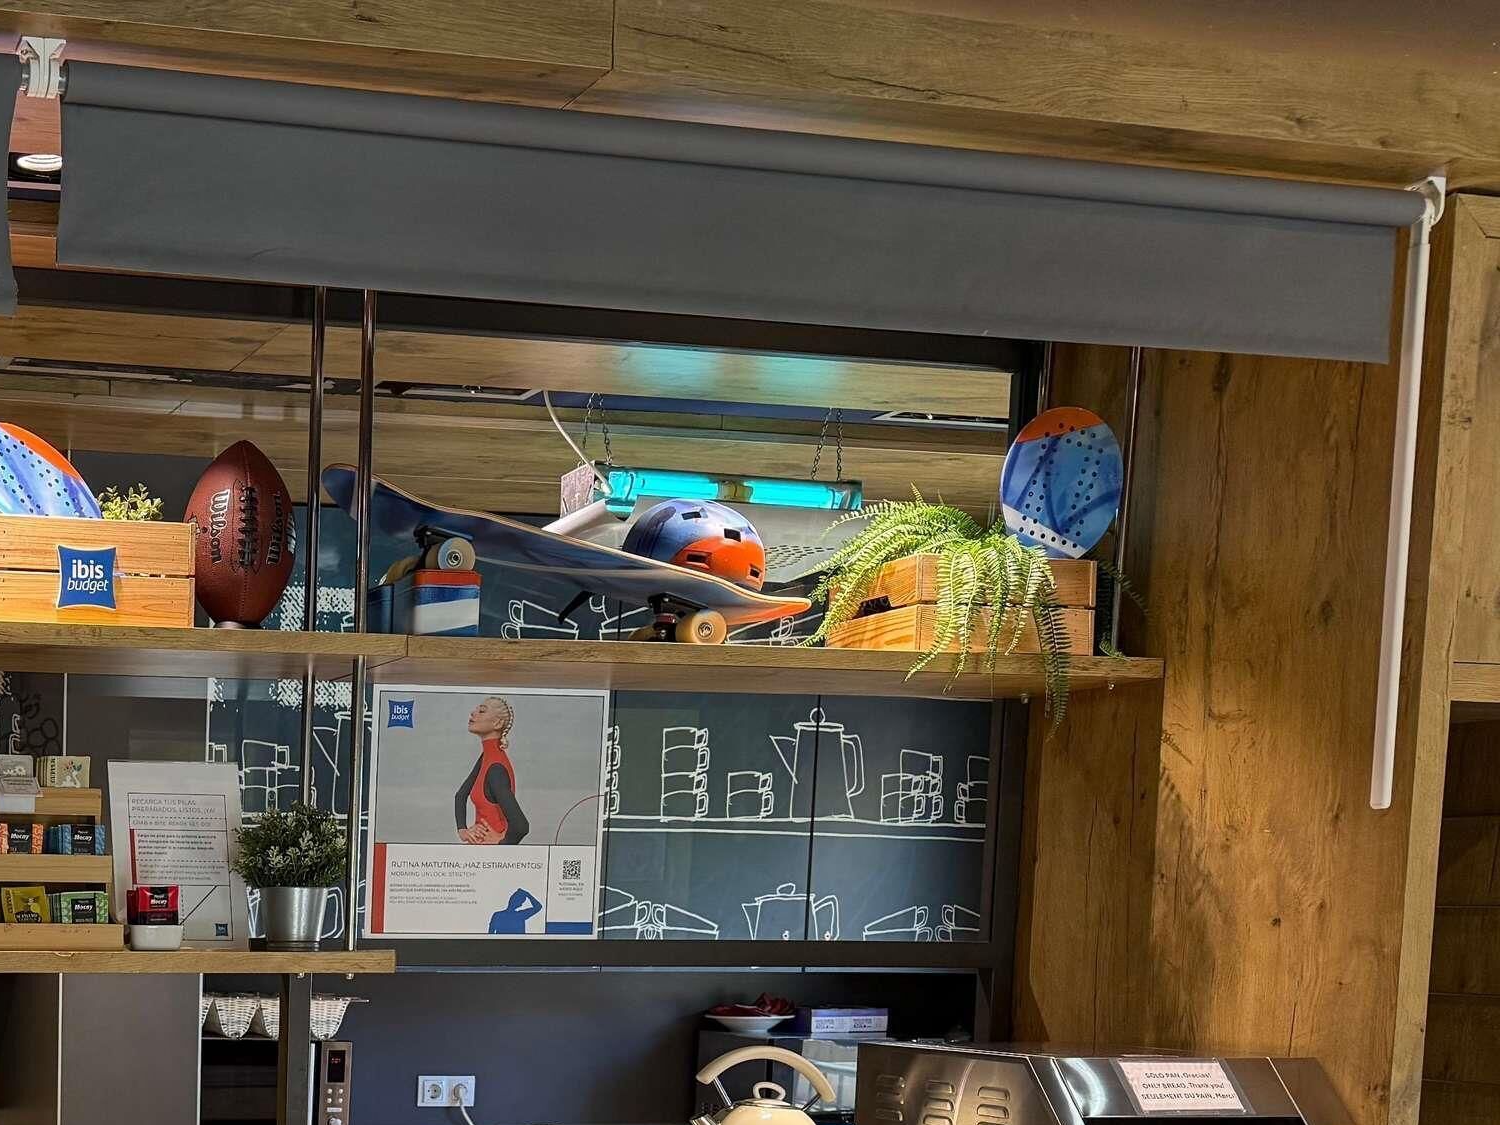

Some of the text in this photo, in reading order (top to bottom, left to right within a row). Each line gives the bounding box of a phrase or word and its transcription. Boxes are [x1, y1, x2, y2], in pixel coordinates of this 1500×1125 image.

[210, 488, 231, 566] Wilson
[71, 559, 104, 579] ibis
[67, 577, 109, 594] budget
[393, 704, 409, 714] ibis
[391, 713, 410, 721] budget
[10, 832, 30, 841] Mocay
[74, 834, 92, 842] Mocay
[391, 861, 419, 869] RUTINA
[482, 861, 544, 870] ESTIRAMIENTOS!
[74, 903, 94, 911] Mocay
[1141, 1092, 1183, 1100] SEULEMENT
